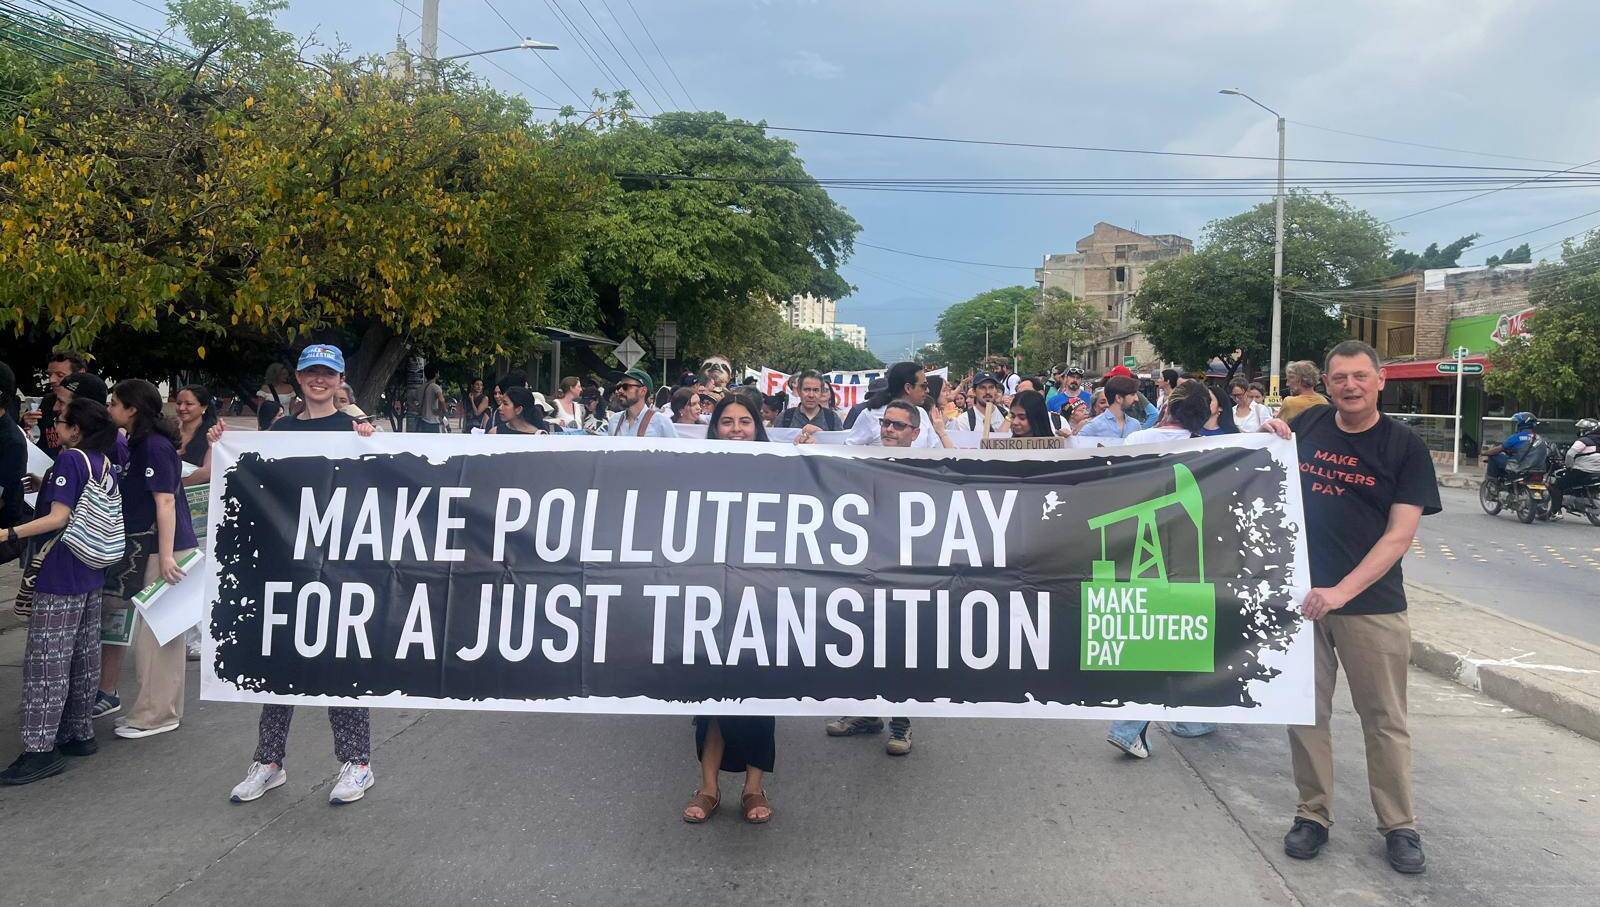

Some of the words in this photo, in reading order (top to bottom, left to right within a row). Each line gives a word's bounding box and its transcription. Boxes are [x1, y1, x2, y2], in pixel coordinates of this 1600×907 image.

[980, 439, 1023, 450] NUESTRO
[1026, 439, 1061, 450] FUTURO
[1313, 449, 1359, 467] MAKE
[1299, 462, 1376, 488] OLLUTERS
[1311, 481, 1345, 496] PAY
[293, 486, 472, 562] MAKE
[492, 487, 870, 567] POLLUTERS
[898, 490, 1020, 568] PAY
[1087, 587, 1147, 613] MAKE
[261, 581, 375, 659] FOR
[394, 582, 436, 660] A
[455, 583, 622, 664] JUST
[642, 584, 1051, 670] TRANSITION
[1087, 614, 1208, 640] POLLUTERS
[1086, 641, 1124, 665] PAY
